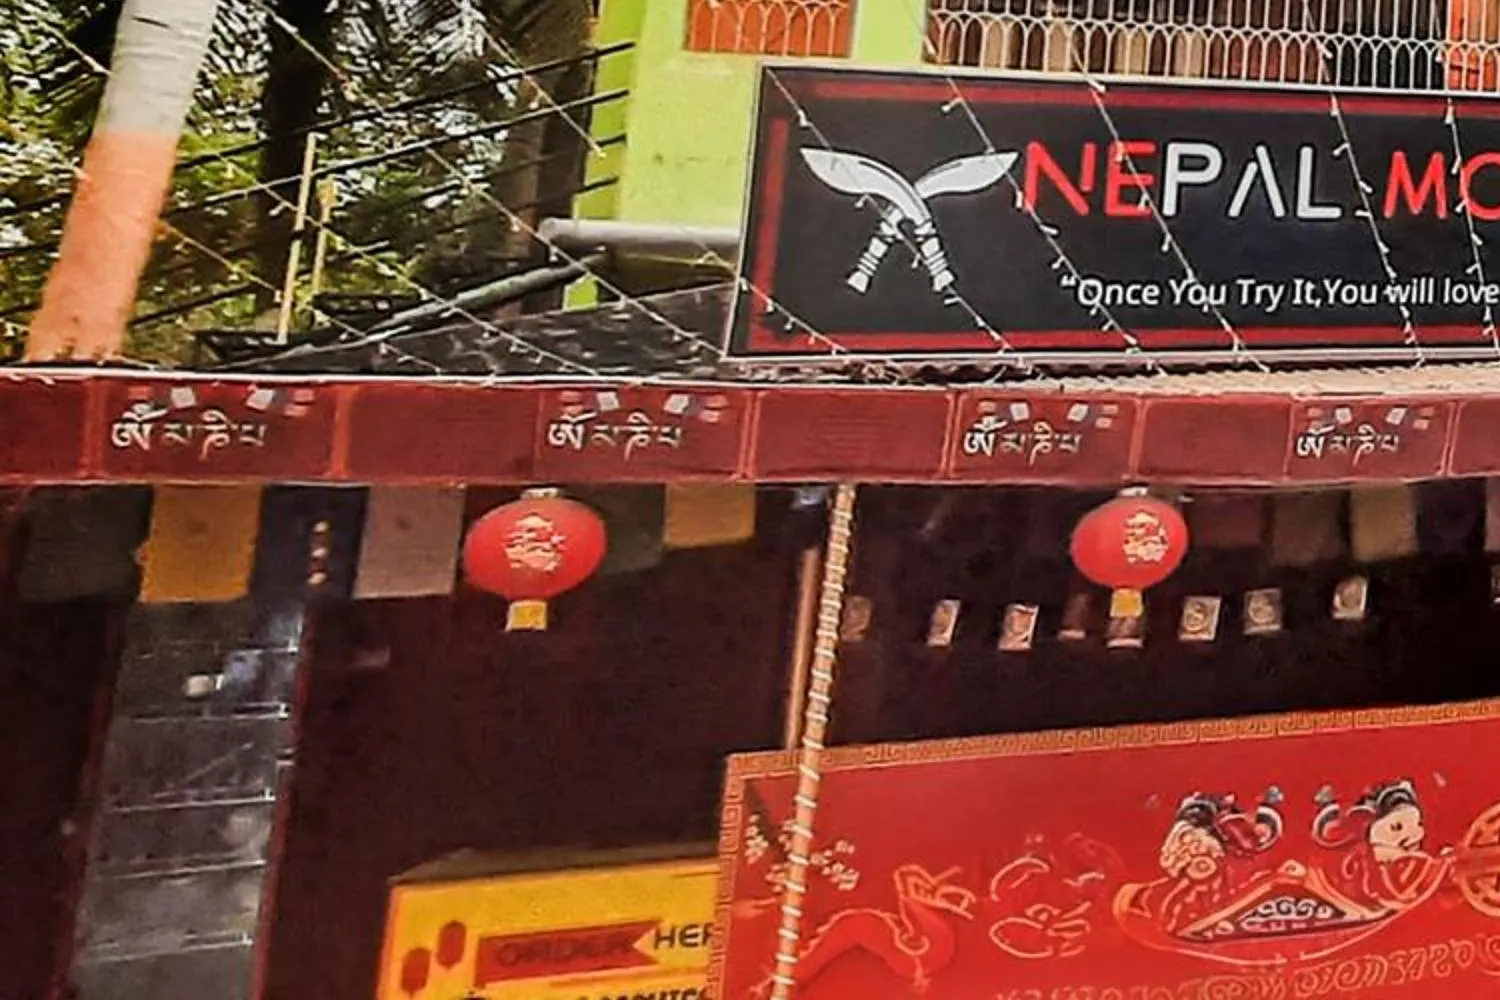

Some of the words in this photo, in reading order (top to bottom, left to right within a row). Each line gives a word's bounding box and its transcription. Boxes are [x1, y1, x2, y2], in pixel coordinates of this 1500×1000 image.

[1024, 141, 1341, 219] NEPAL
[1168, 278, 1227, 306] You
[1236, 278, 1284, 312] Try
[1384, 277, 1435, 304] will
[1443, 277, 1500, 304] love
